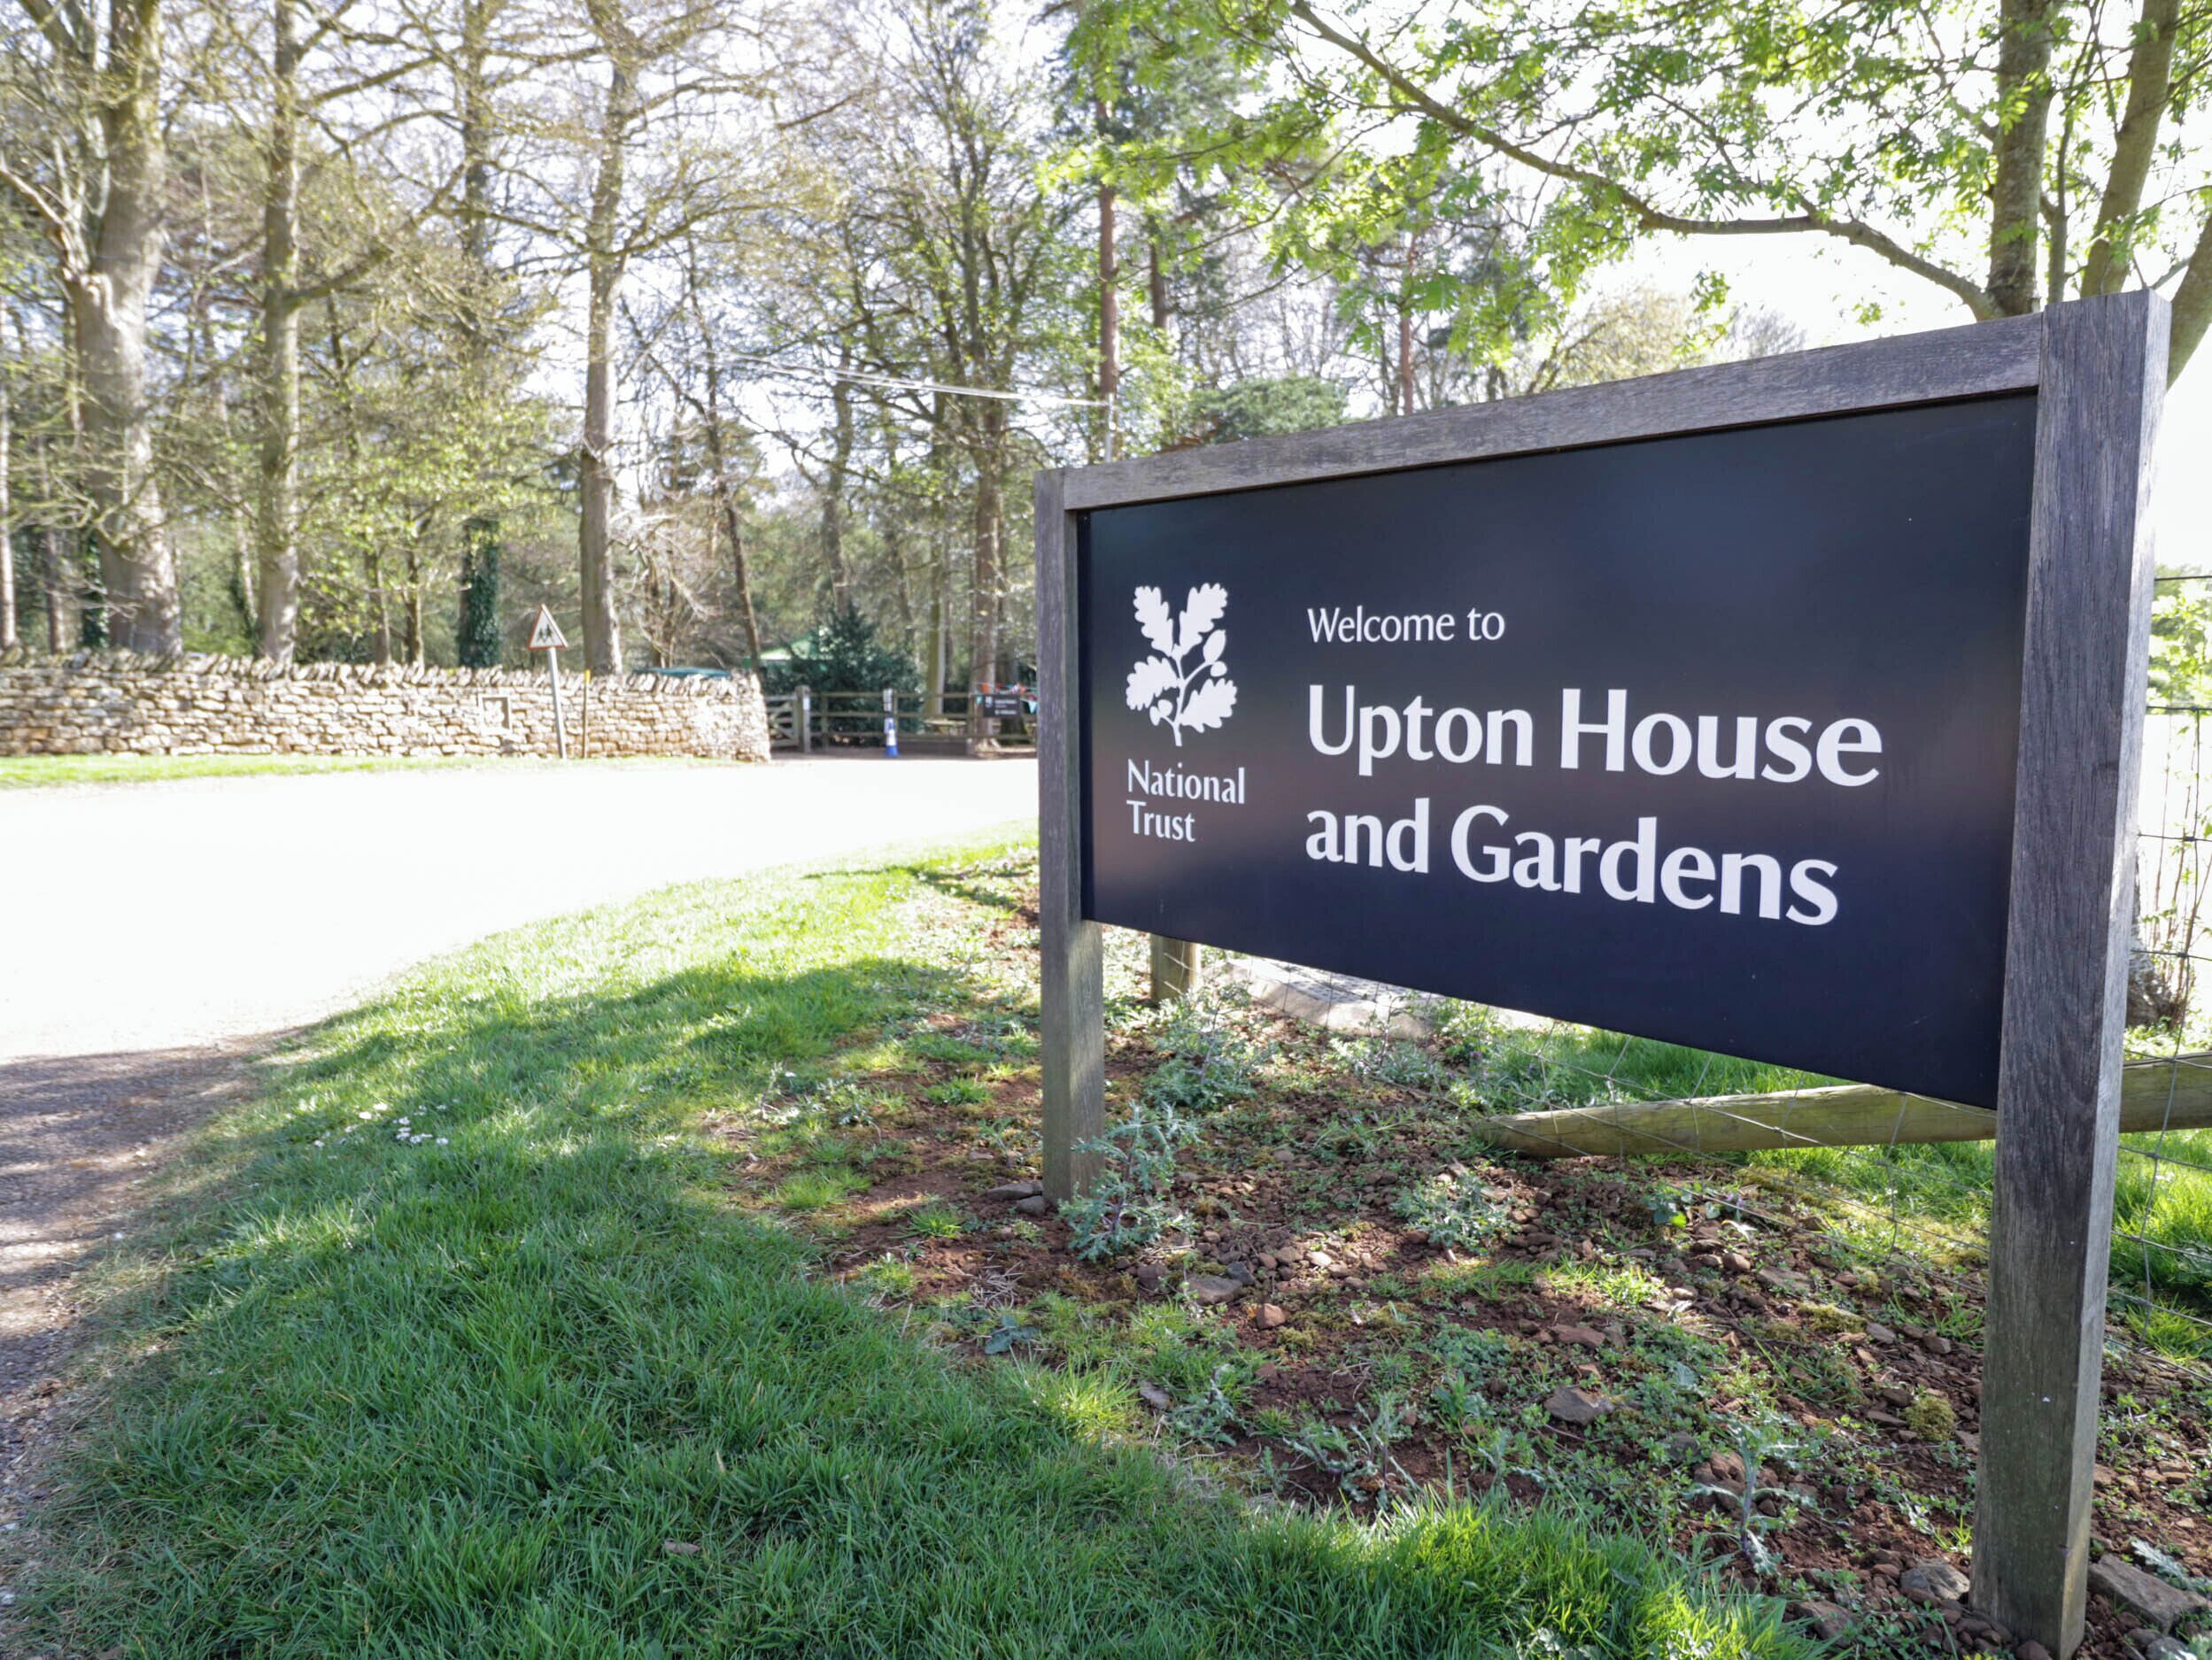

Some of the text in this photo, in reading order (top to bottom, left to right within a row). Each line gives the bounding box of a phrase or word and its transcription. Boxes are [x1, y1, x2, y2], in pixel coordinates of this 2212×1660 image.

[1307, 605, 1505, 643] Welcome to
[1309, 683, 1883, 787] Upton House
[1125, 758, 1246, 805] National
[1125, 799, 1196, 843] Trust
[1305, 797, 1838, 926] and Gardens
